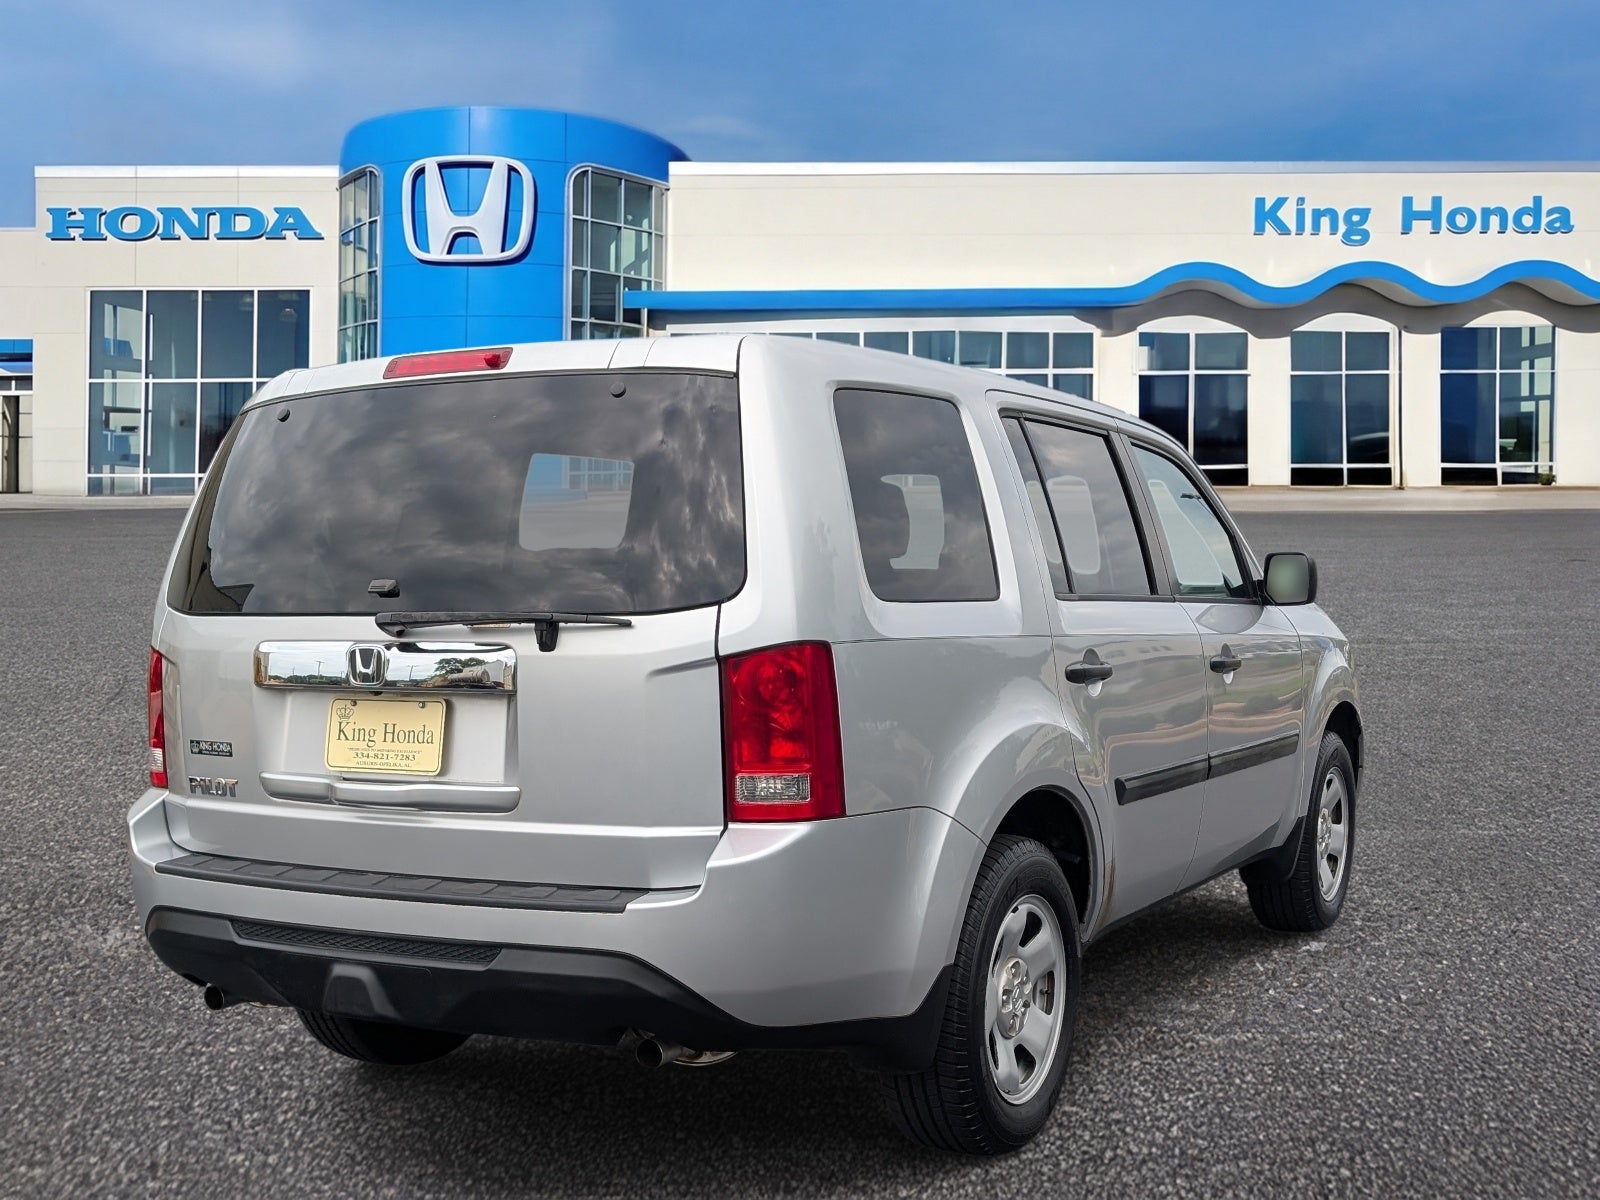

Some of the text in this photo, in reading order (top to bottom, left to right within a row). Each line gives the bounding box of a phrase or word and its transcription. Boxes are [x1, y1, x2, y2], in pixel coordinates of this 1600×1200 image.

[45, 206, 325, 242] HONDA
[1253, 195, 1575, 247] King Honda
[200, 741, 231, 752] KING HONDA
[336, 721, 434, 748] King Honda
[353, 751, 416, 762] 334-821-7283
[188, 776, 238, 797] PILOT
